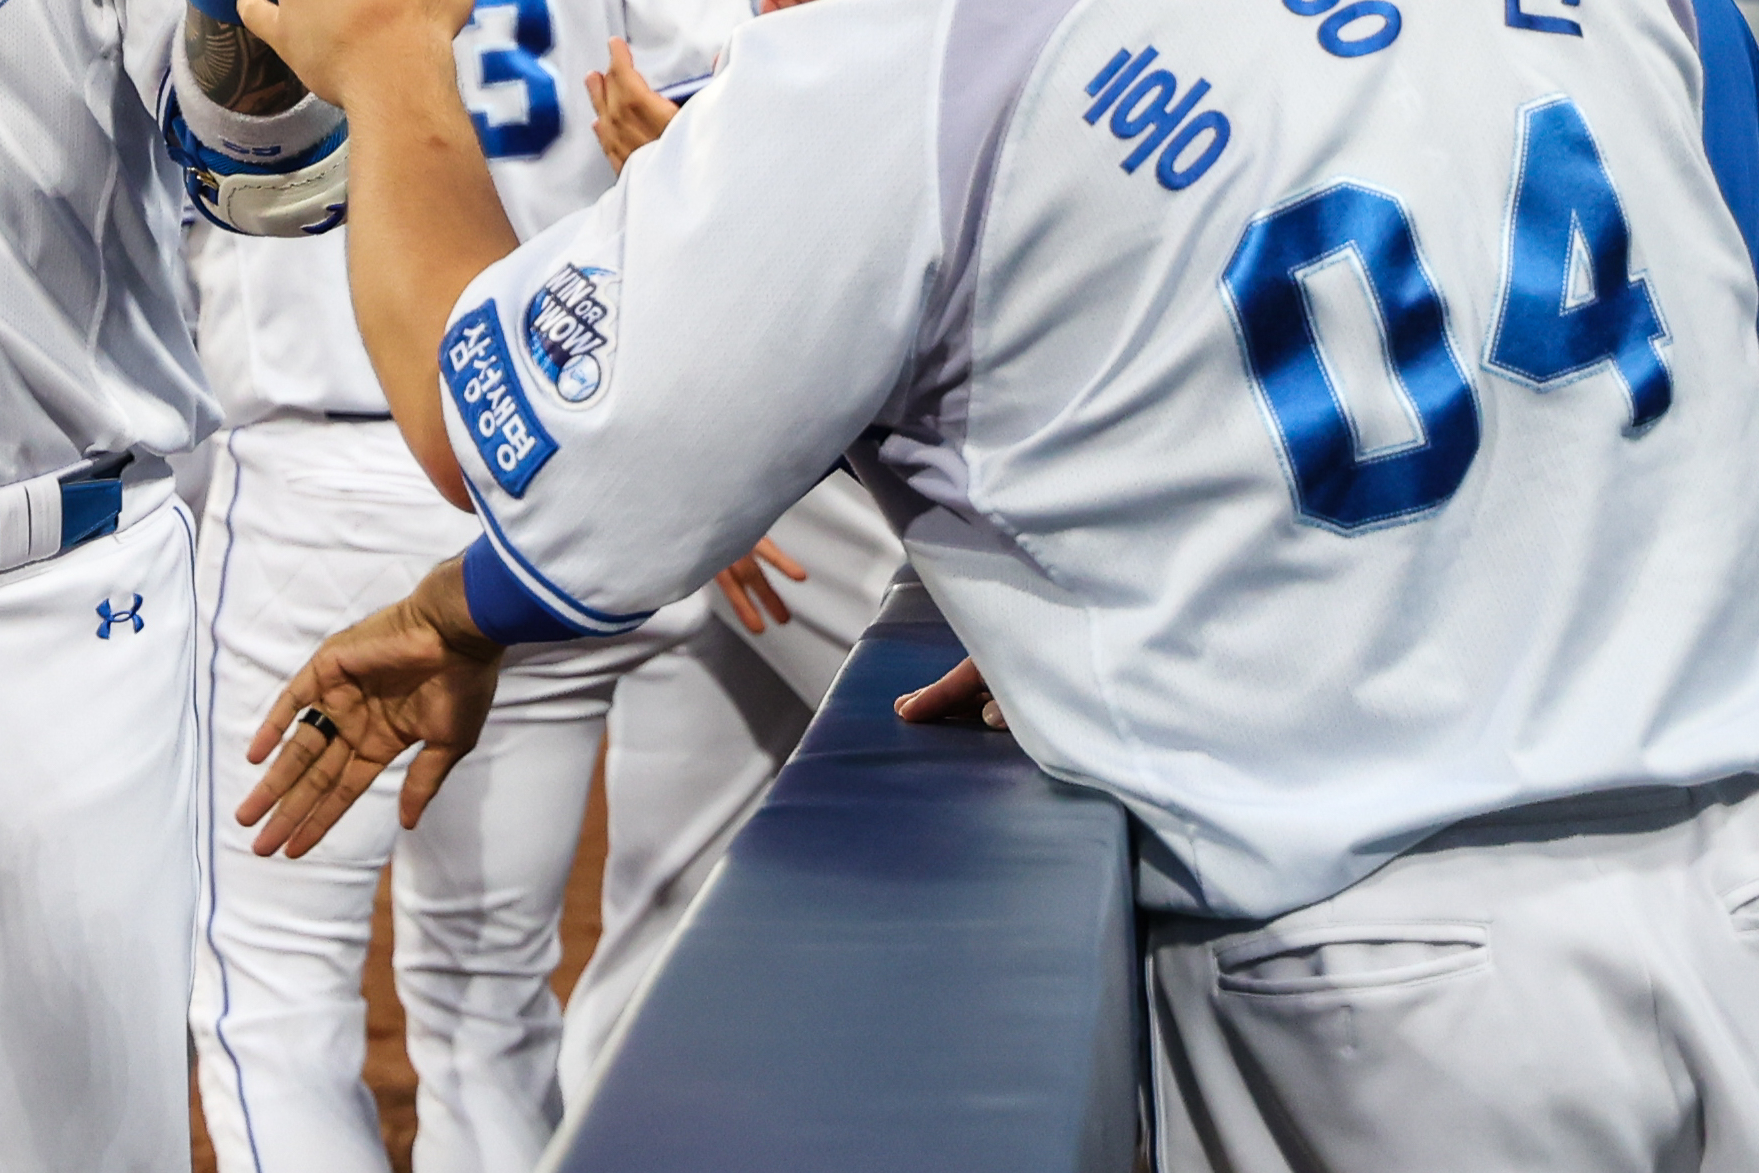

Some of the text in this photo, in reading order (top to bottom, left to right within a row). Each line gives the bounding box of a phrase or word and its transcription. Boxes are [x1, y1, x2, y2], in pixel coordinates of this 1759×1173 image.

[532, 294, 604, 356] WOW
[545, 266, 603, 326] WIN OR
[1218, 92, 1674, 538] 04
[448, 321, 537, 473] 삼성생명
